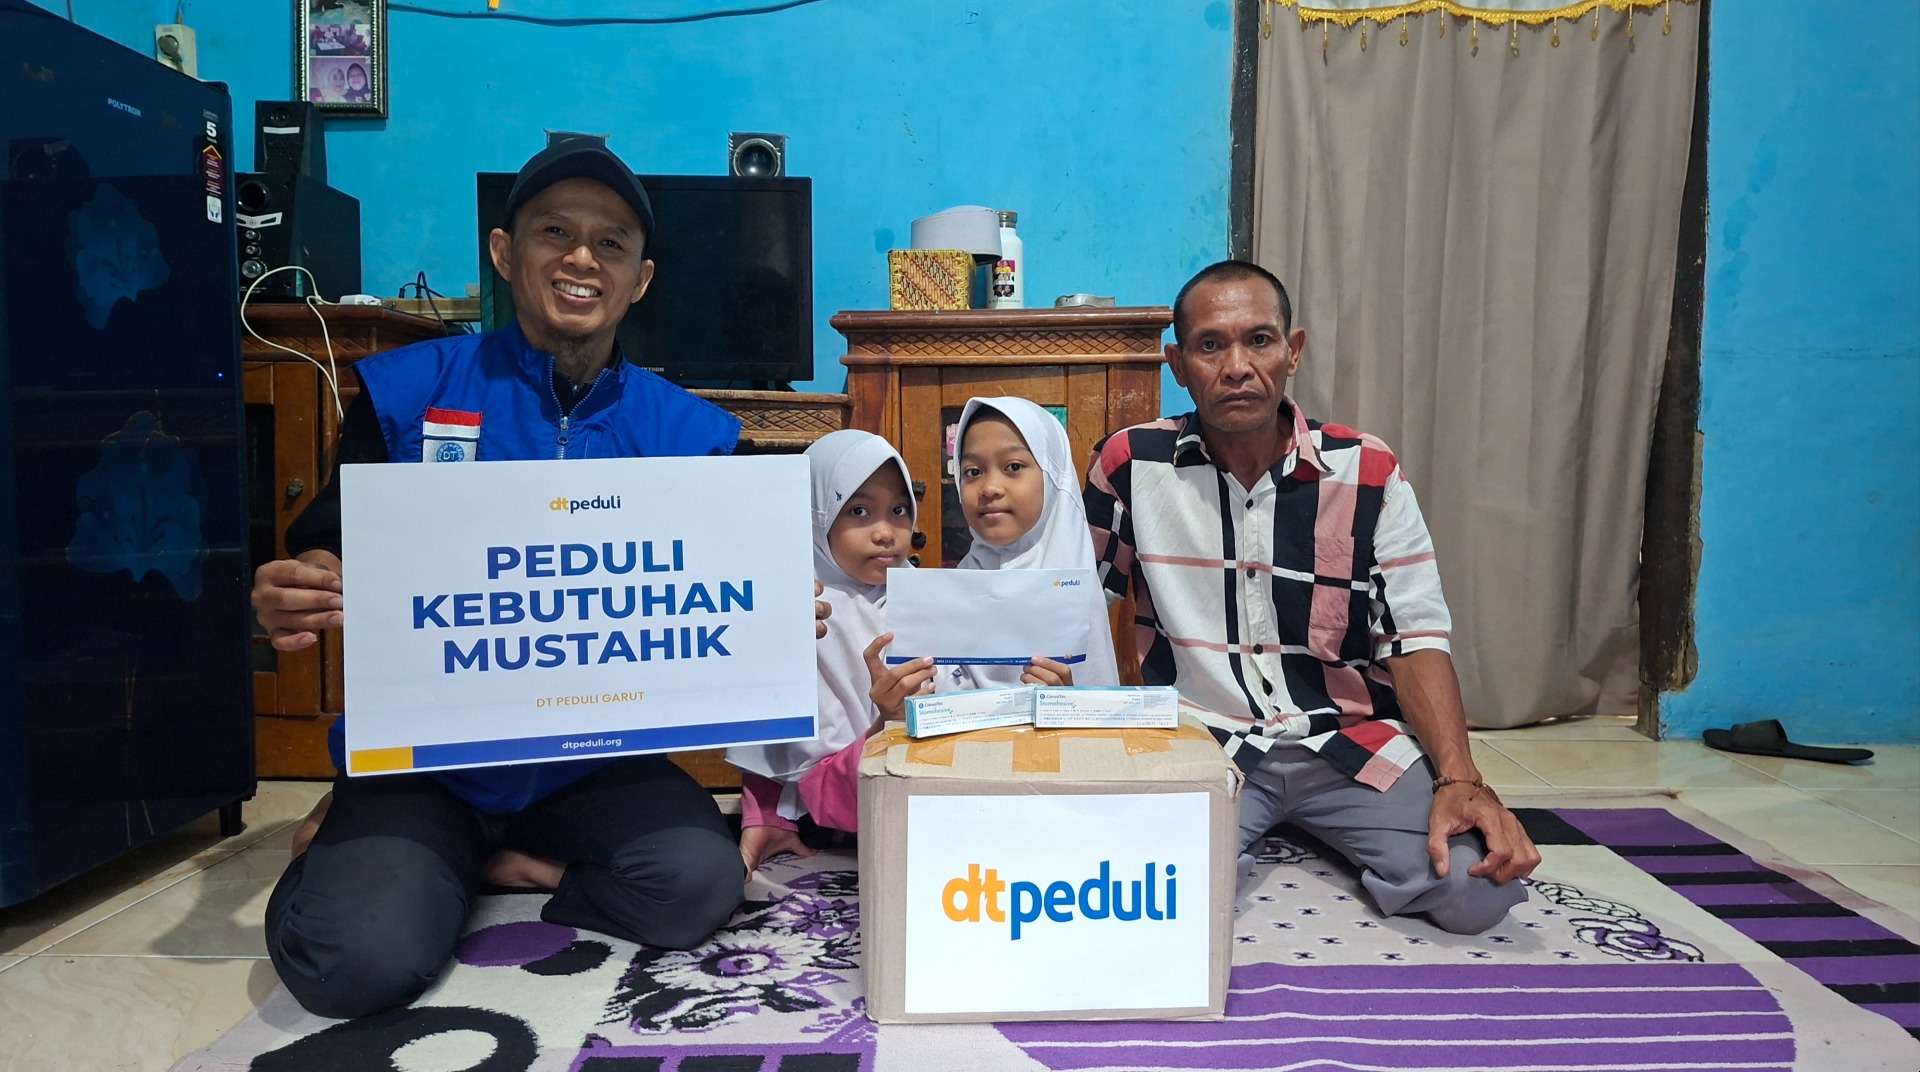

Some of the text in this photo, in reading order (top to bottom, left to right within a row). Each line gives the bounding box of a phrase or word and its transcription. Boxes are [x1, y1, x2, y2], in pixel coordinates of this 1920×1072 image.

[108, 97, 141, 117] POLYTRON
[206, 121, 217, 137] 5
[443, 451, 458, 460] DT
[549, 495, 621, 514] dtpeduli
[487, 540, 684, 579] PEDULI
[413, 580, 754, 629] KEBUTUHAN
[444, 624, 732, 673] MUSTAHIK
[536, 691, 645, 708] DT PEDULI GARUT
[561, 738, 622, 750] dtpeduli.org
[941, 859, 1177, 941] dtpeduli
